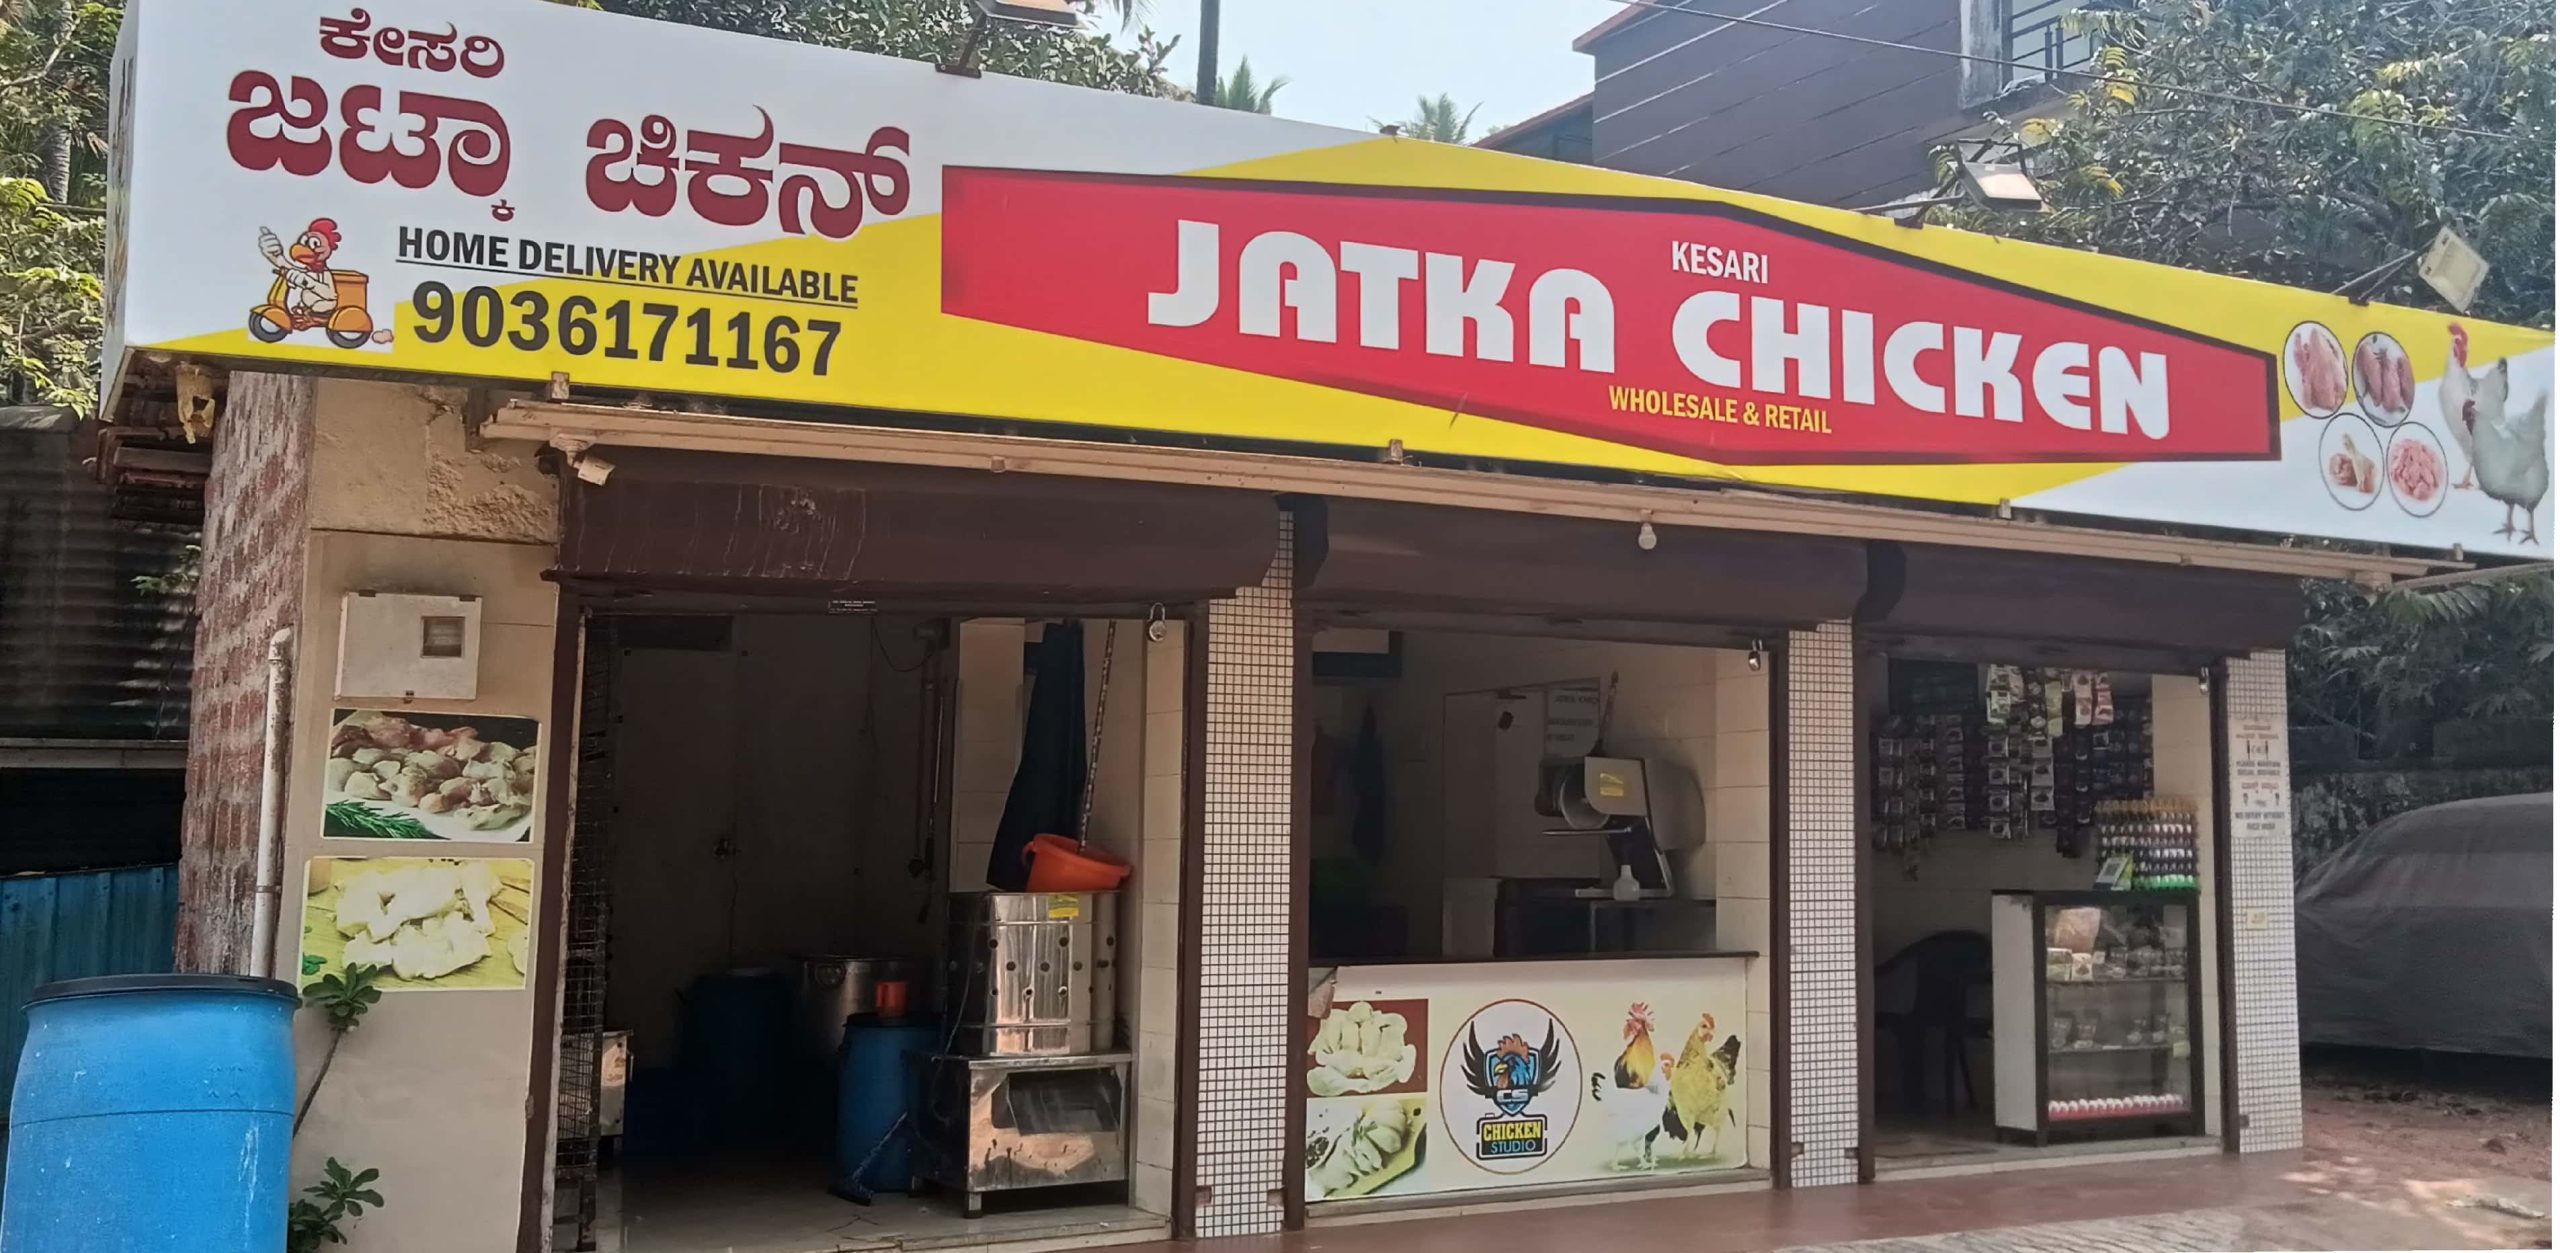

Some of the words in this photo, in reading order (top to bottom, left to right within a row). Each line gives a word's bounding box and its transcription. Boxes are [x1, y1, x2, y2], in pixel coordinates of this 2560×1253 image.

[319, 8, 505, 78] ಕೇಸರಿ
[227, 70, 515, 222] ಜಟ್ಕಾ
[586, 104, 910, 239] ಚಿಕನ್
[399, 226, 508, 268] HOME
[519, 241, 681, 286] DELIVERY
[686, 259, 858, 304] AVAILABLE
[1672, 240, 1769, 285] KESARI
[413, 280, 842, 377] 9036171167
[1148, 219, 1615, 373] JATKA
[1672, 290, 2170, 440] CHICKEN
[1609, 385, 1738, 423] WHOLESALE
[1743, 400, 1760, 426] &
[1765, 404, 1832, 433] RETAIL
[1496, 1088, 1529, 1103] CS
[1483, 1121, 1541, 1141] CHICKEN
[1490, 1139, 1536, 1154] STUDIO
